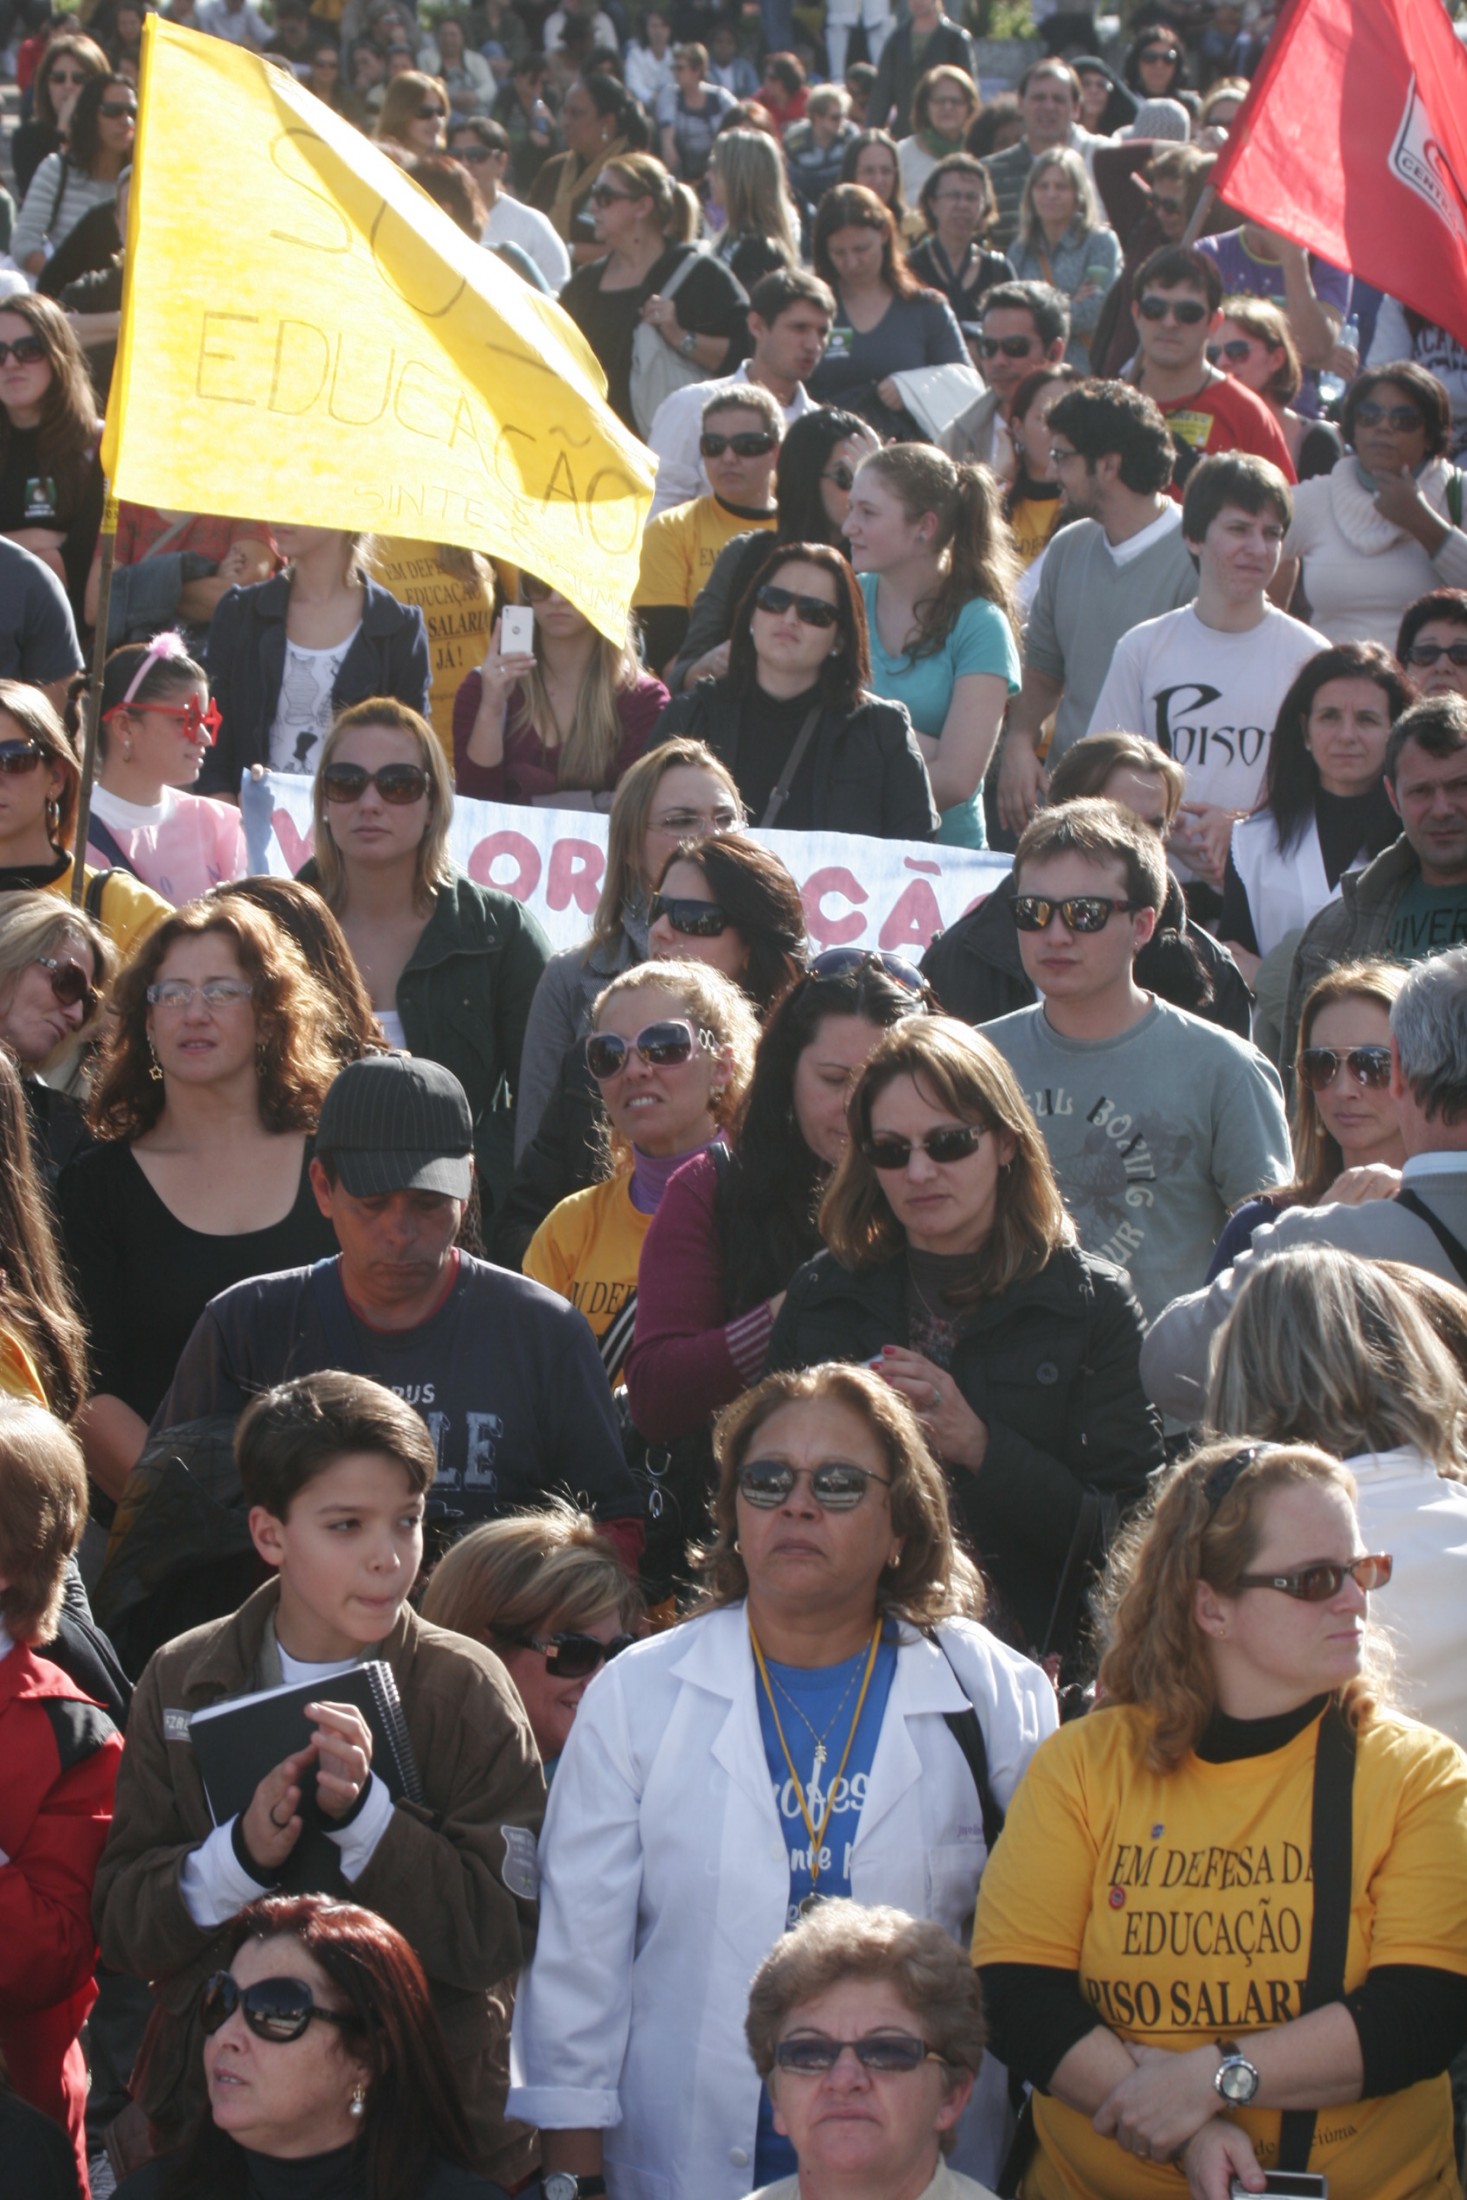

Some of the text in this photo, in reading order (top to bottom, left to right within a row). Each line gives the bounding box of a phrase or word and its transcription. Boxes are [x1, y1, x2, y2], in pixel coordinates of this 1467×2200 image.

[1108, 1843, 1159, 1888] EM
[1159, 1845, 1275, 1891] DEFESA
[1121, 1896, 1302, 1968] EDUCAÇÃO
